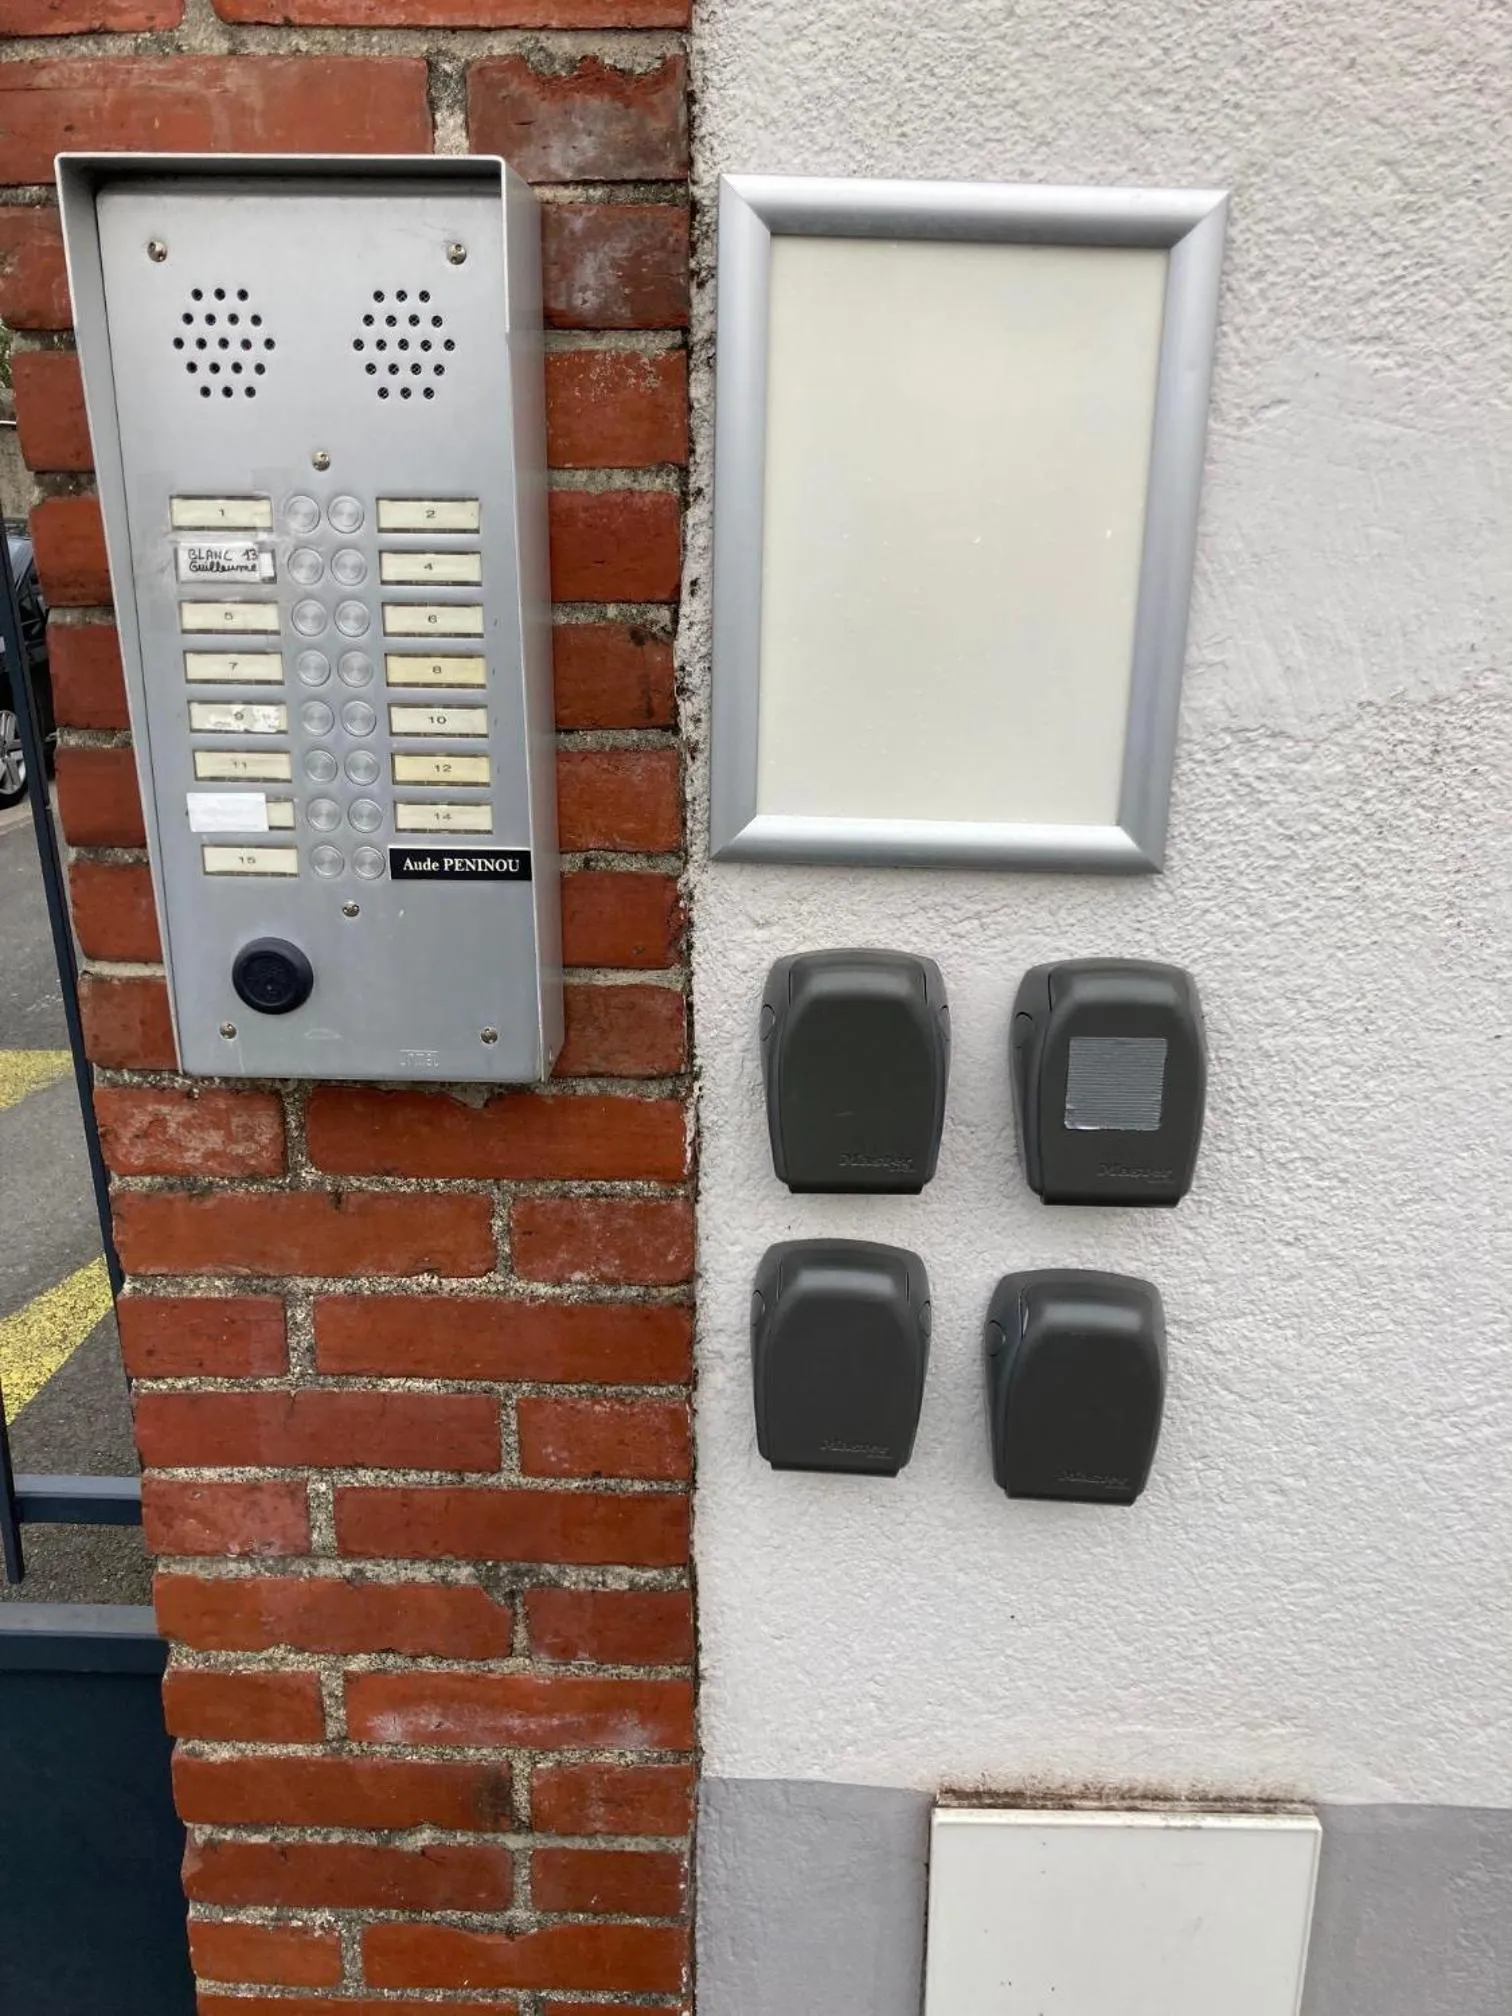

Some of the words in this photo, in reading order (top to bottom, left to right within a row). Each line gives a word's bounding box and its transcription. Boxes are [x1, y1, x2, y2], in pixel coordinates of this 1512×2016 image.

[425, 509, 437, 519] 2
[228, 661, 239, 671] 7
[428, 715, 447, 725] 10
[434, 764, 452, 773] 12
[434, 812, 453, 821] 14
[402, 858, 440, 872] Aude
[443, 858, 520, 873] PENINOU
